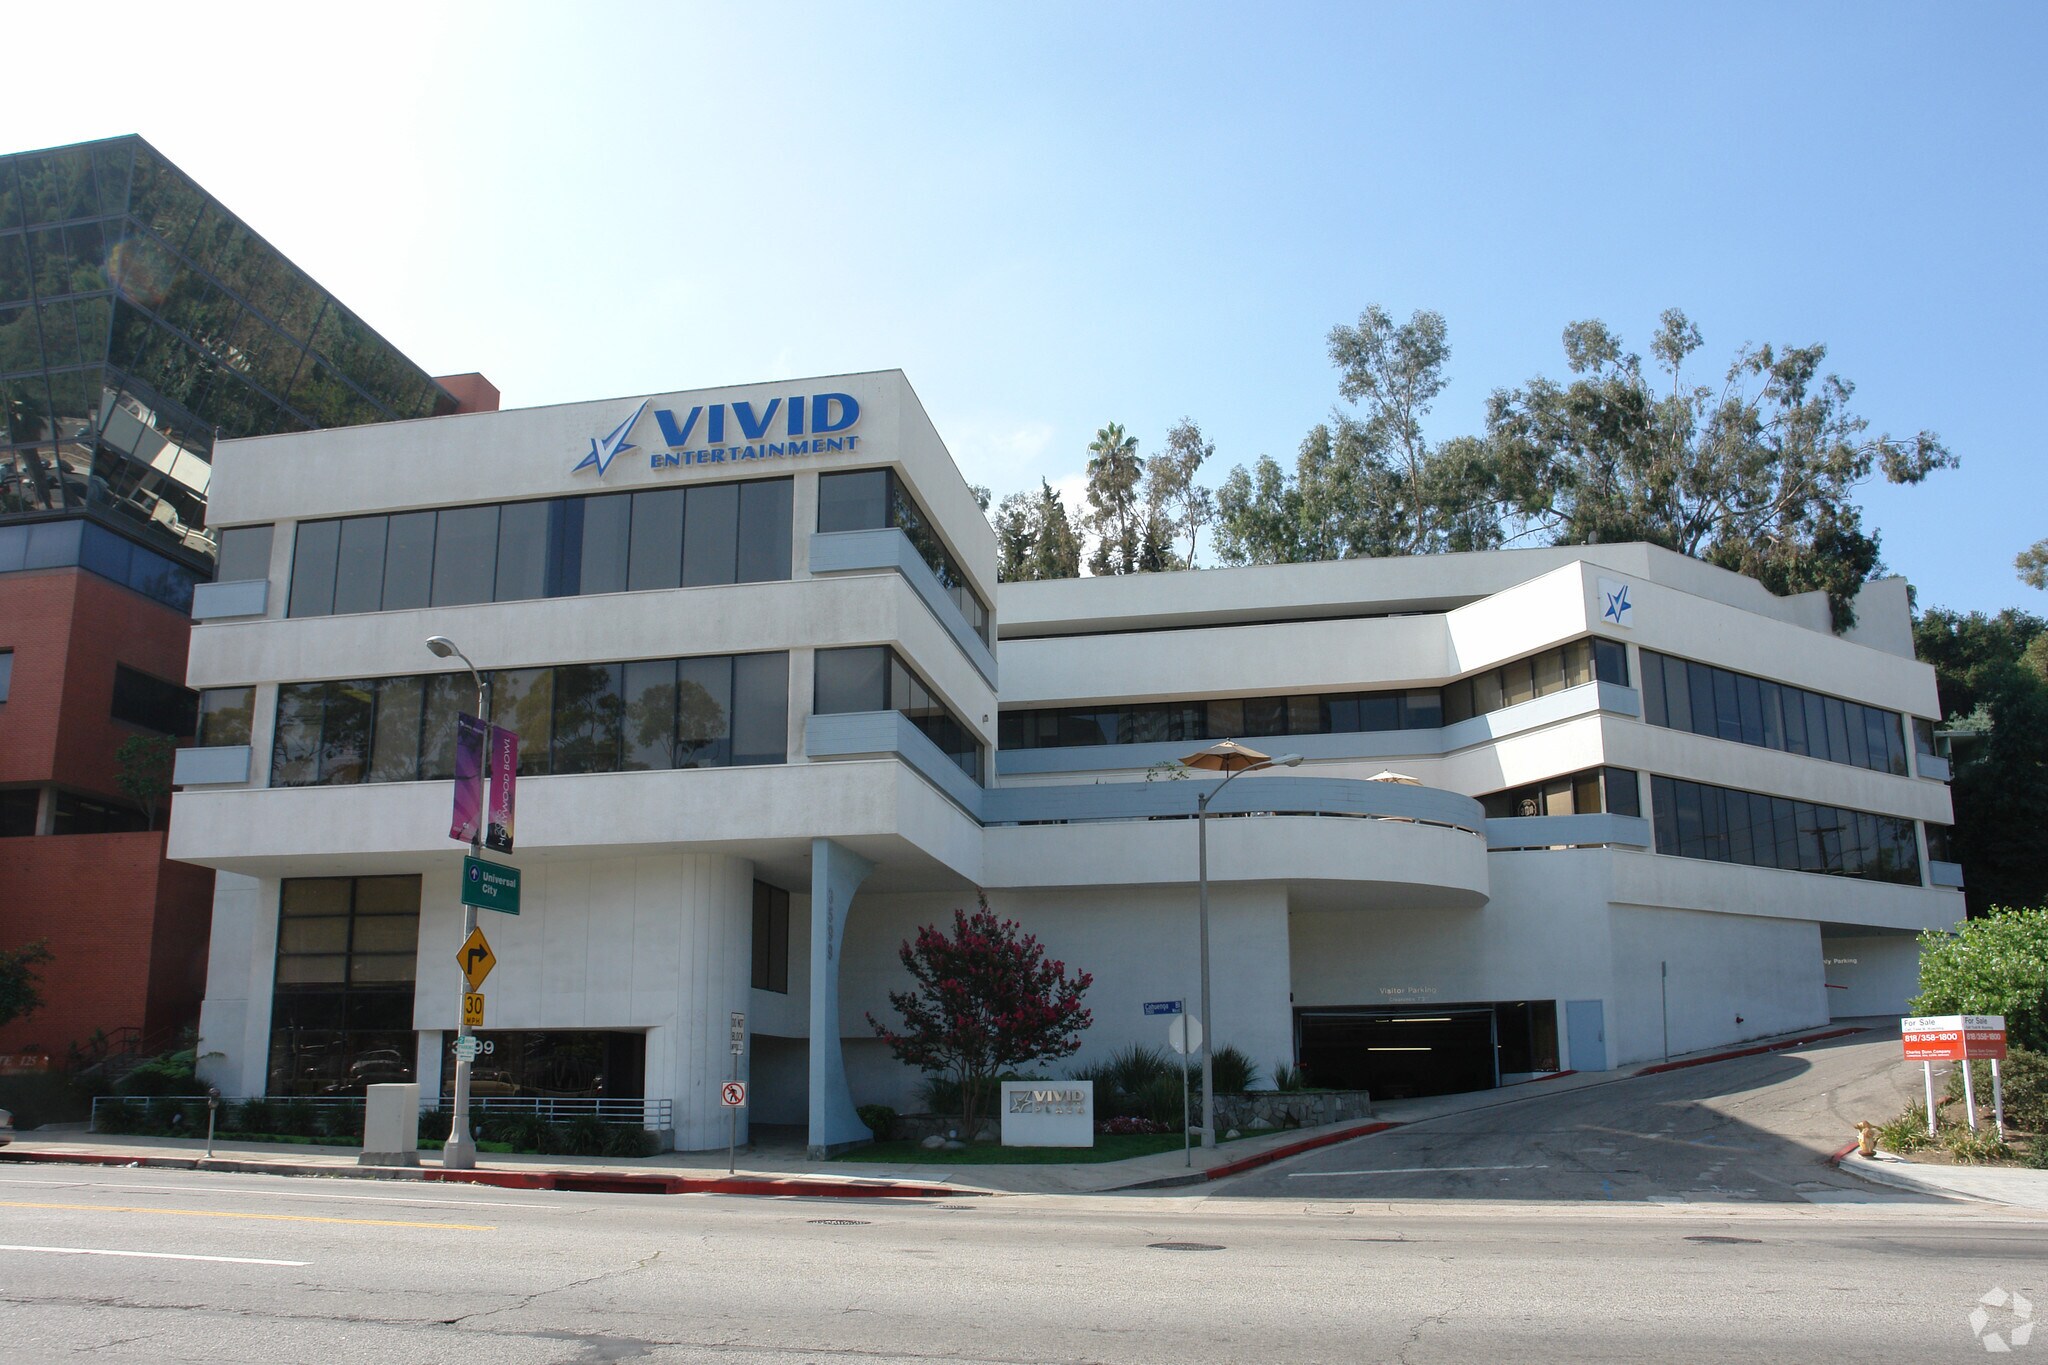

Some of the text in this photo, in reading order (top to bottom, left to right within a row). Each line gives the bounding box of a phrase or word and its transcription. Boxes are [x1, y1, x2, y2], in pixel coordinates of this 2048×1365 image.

[653, 392, 861, 448] VIVID
[650, 435, 860, 469] ENTERTAINMENT
[498, 738, 511, 846] HOLLYWOOD BOWL
[482, 871, 517, 888] Universal
[482, 883, 499, 897] City
[1408, 985, 1437, 994] Parking
[466, 996, 482, 1014] 30
[1145, 1003, 1169, 1011] Cahuenga
[466, 1017, 481, 1025] MPH
[1904, 1018, 1936, 1027] For Sale
[1965, 1016, 1988, 1024] For Sale
[1904, 1033, 1958, 1042] 818/358-1800
[451, 1040, 495, 1055] 399
[1033, 1090, 1084, 1103] VIVID
